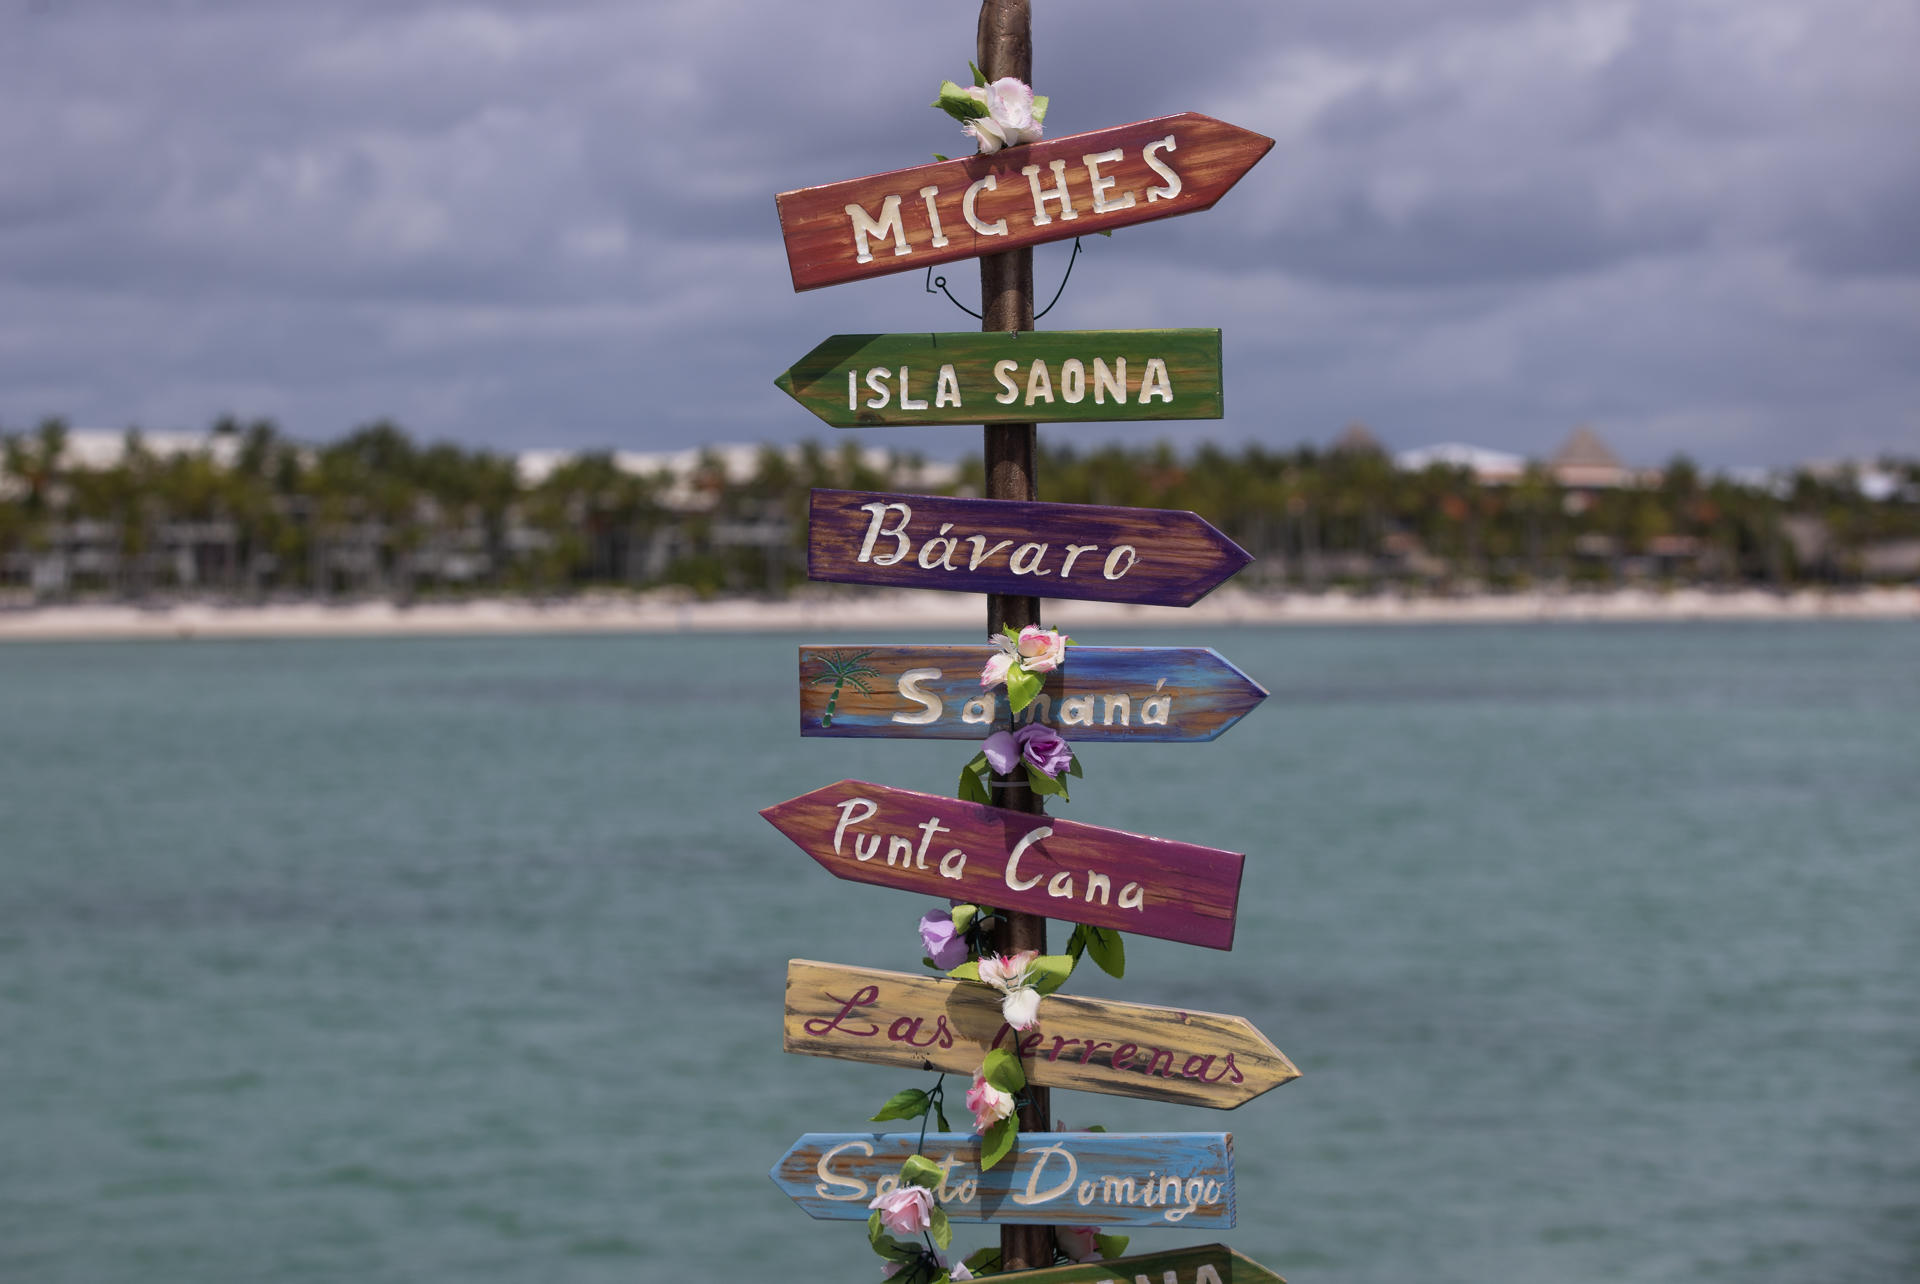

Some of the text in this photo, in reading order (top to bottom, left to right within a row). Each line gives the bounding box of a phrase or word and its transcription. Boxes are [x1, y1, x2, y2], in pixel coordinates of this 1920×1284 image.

[845, 134, 1182, 264] MICHES
[848, 357, 1174, 411] ISLA SAONA
[857, 501, 1139, 580] Bávaro
[833, 797, 1144, 912] Punta Cana
[803, 985, 953, 1049] Las
[1013, 1141, 1224, 1223] Domingo
